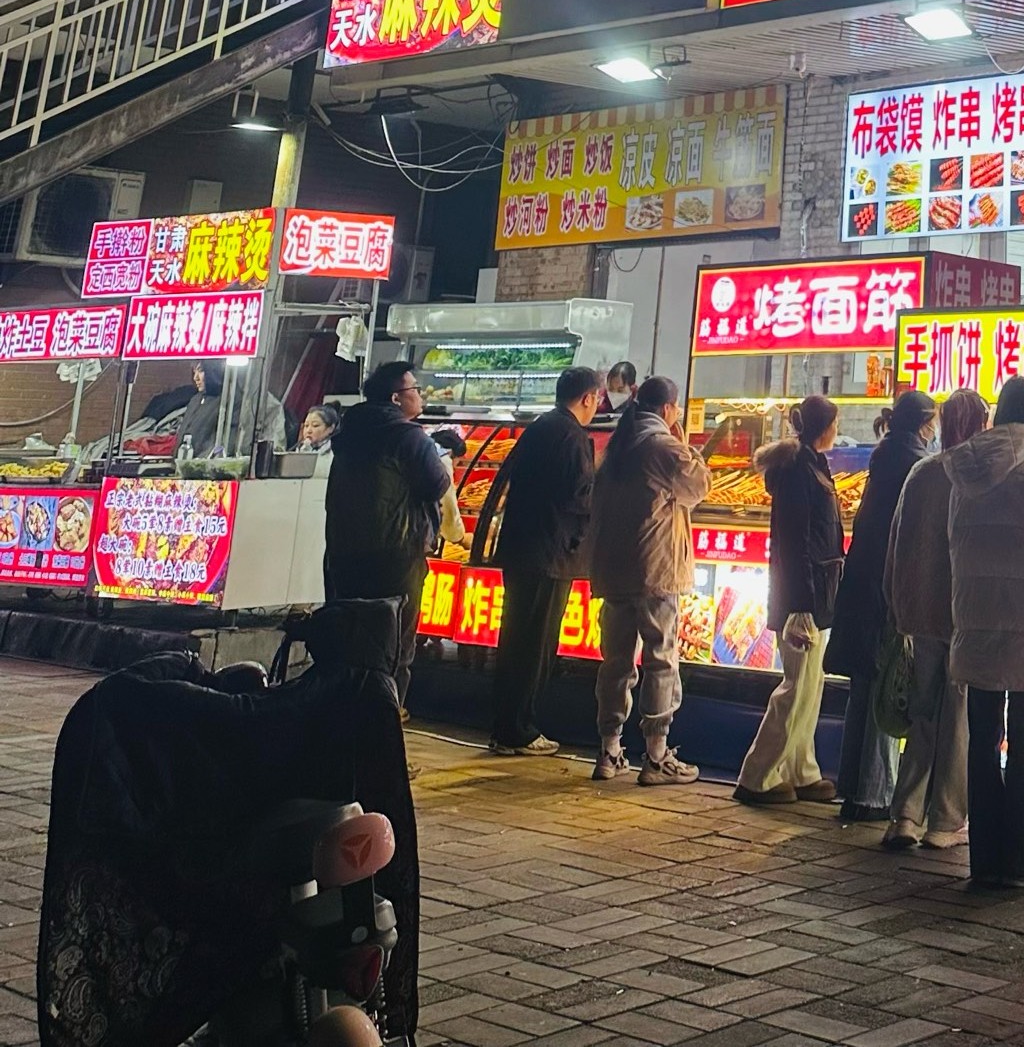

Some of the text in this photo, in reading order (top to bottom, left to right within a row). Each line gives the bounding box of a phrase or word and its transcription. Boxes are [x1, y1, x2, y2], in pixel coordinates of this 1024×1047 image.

[330, 3, 377, 51] 天水
[852, 93, 924, 159] 布袋馍
[932, 86, 981, 150] 炸串
[508, 144, 537, 184] 炒饼
[545, 138, 575, 179] 炒面
[584, 132, 614, 177] 炒饭
[503, 188, 608, 238] 炒河粉 炒米粉
[94, 226, 147, 257] 手擀粉
[155, 217, 272, 284] 甘肃 麻辣烫
[285, 216, 395, 273] 泡菜豆腐
[88, 261, 142, 292] 定西宽粉
[148, 258, 182, 285] 天水
[936, 260, 971, 307] 炸串
[754, 267, 917, 337] 烤面筋
[50, 308, 122, 356] 泡菜豆腐
[904, 320, 982, 394] 手抓饼
